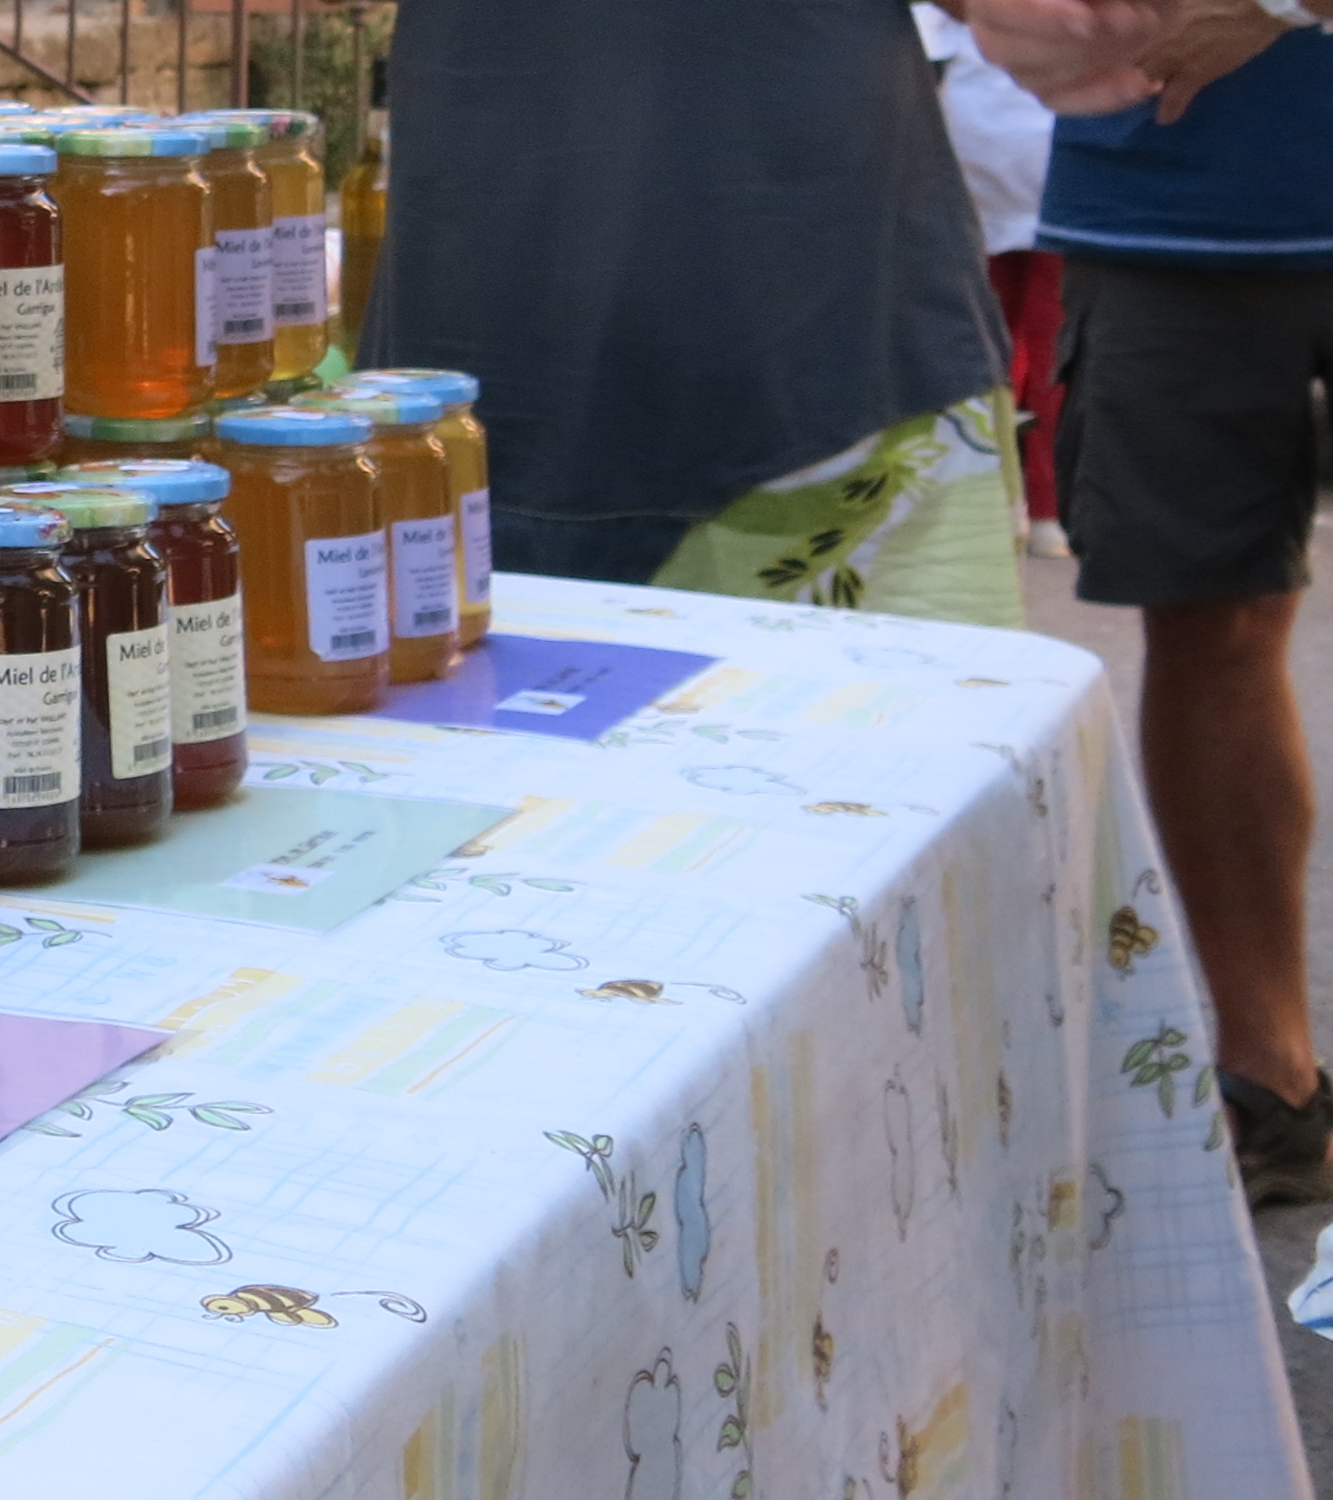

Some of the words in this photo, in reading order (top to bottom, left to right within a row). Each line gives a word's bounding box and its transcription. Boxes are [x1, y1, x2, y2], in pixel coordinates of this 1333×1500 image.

[14, 282, 31, 296] de
[176, 616, 212, 634] Miel
[217, 612, 231, 628] de
[120, 640, 152, 661] Miel
[40, 665, 57, 683] de
